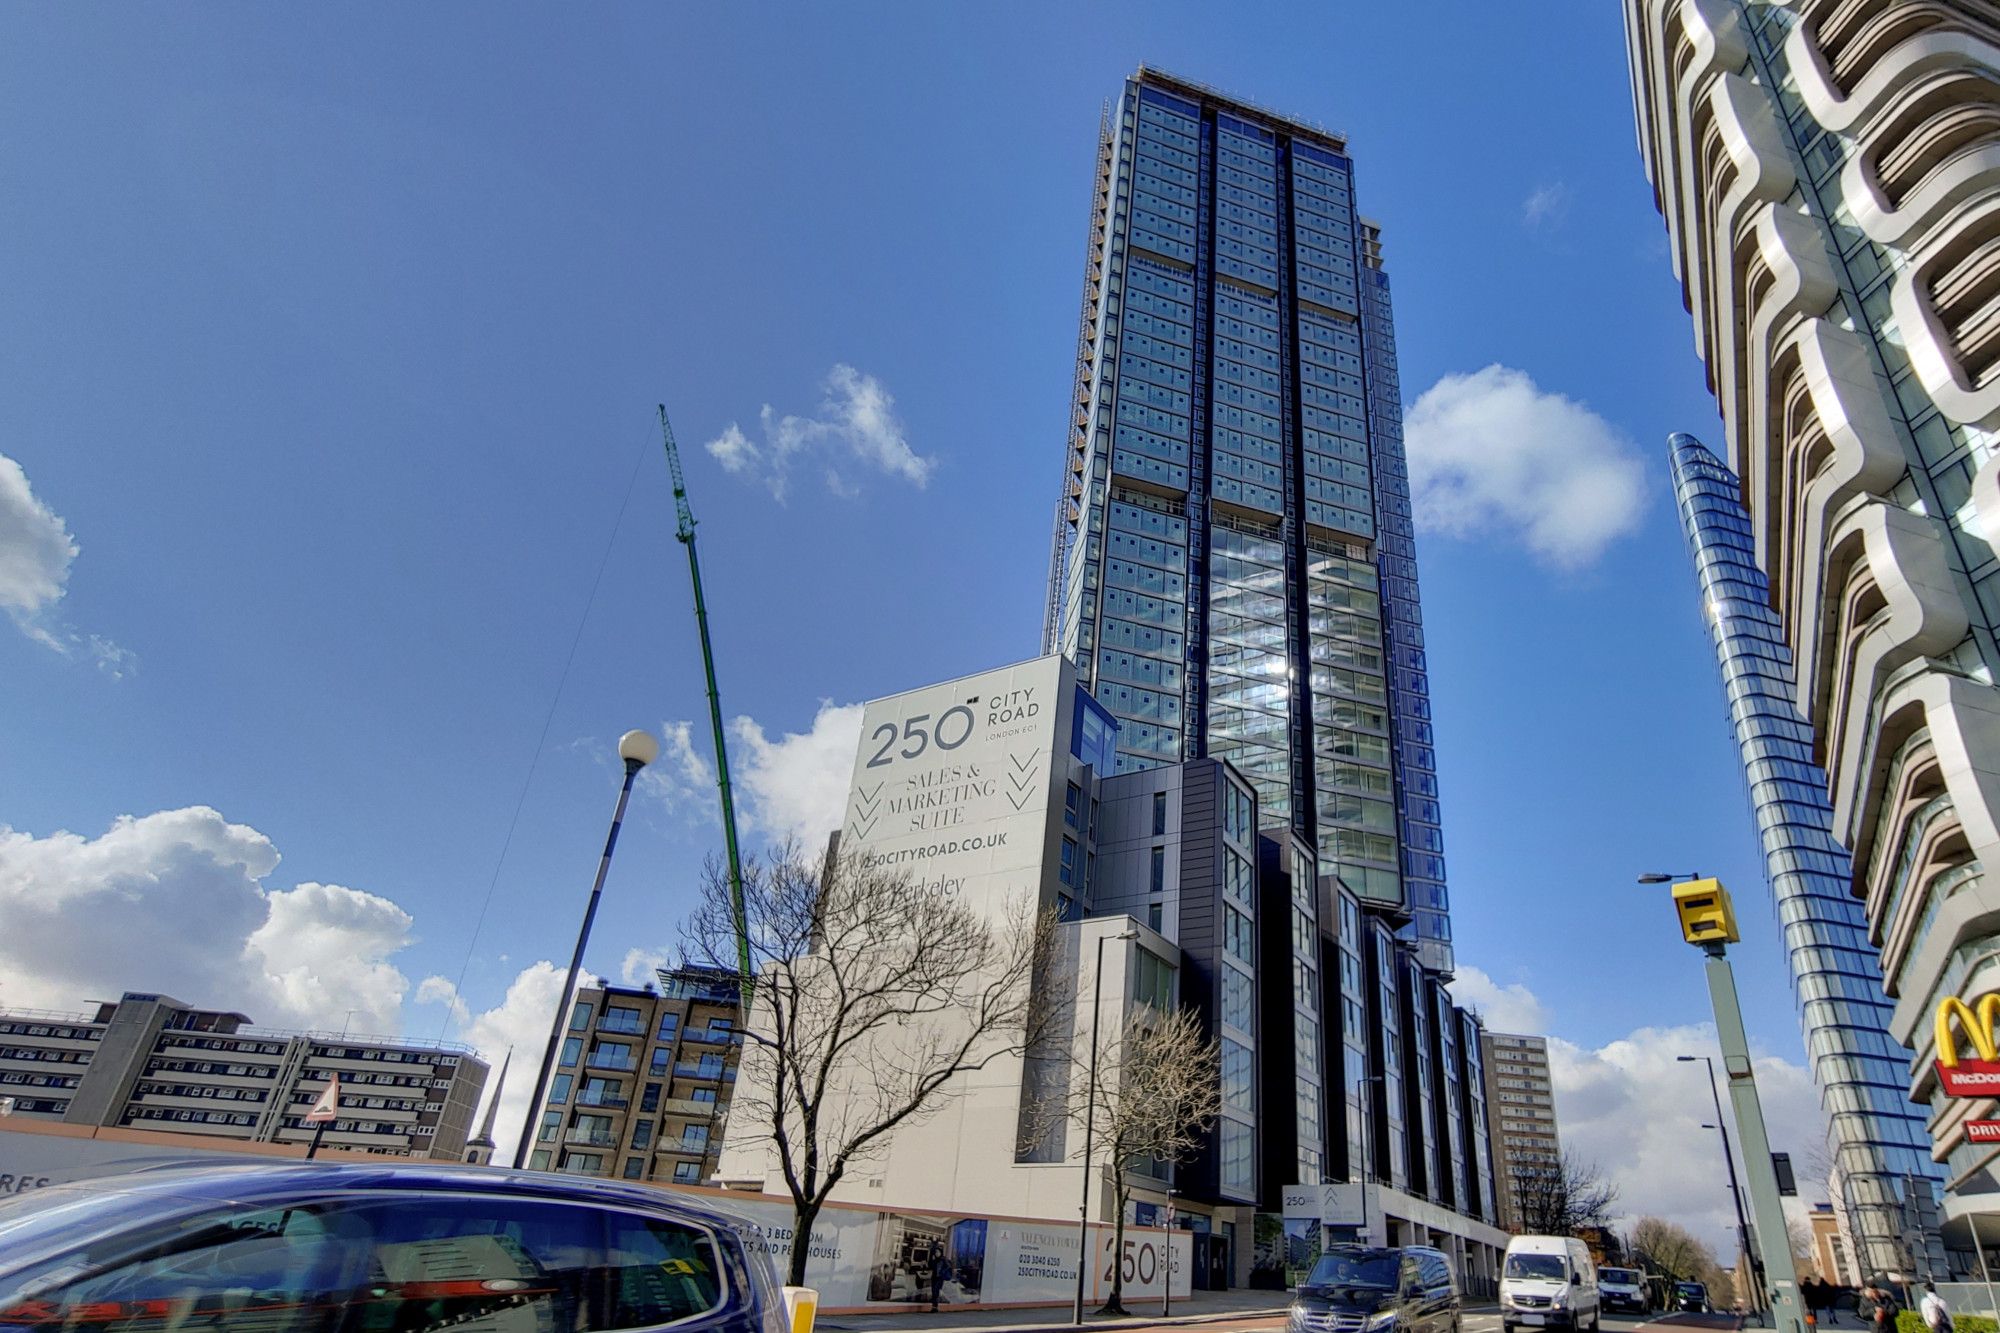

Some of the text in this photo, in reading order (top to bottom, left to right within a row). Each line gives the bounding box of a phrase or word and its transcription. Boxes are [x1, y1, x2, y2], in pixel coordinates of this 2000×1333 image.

[989, 687, 1034, 710] CITY
[987, 703, 1040, 727] ROAD
[866, 705, 975, 769] 250
[985, 728, 1020, 742] LONDON
[906, 762, 980, 791] SALES &
[887, 779, 996, 816] MARKETING
[909, 806, 965, 832] SUITE
[864, 832, 1008, 869] 250CITYROAD.CO.UK
[1286, 1196, 1306, 1207] 250
[766, 1227, 772, 1239] 3
[774, 1228, 823, 1243] BEDOM
[757, 1242, 779, 1254] AND
[781, 1245, 842, 1260] PEHOUSES
[1018, 1253, 1031, 1265] 020
[1160, 1244, 1180, 1258] CTY
[1160, 1259, 1180, 1274] RAD
